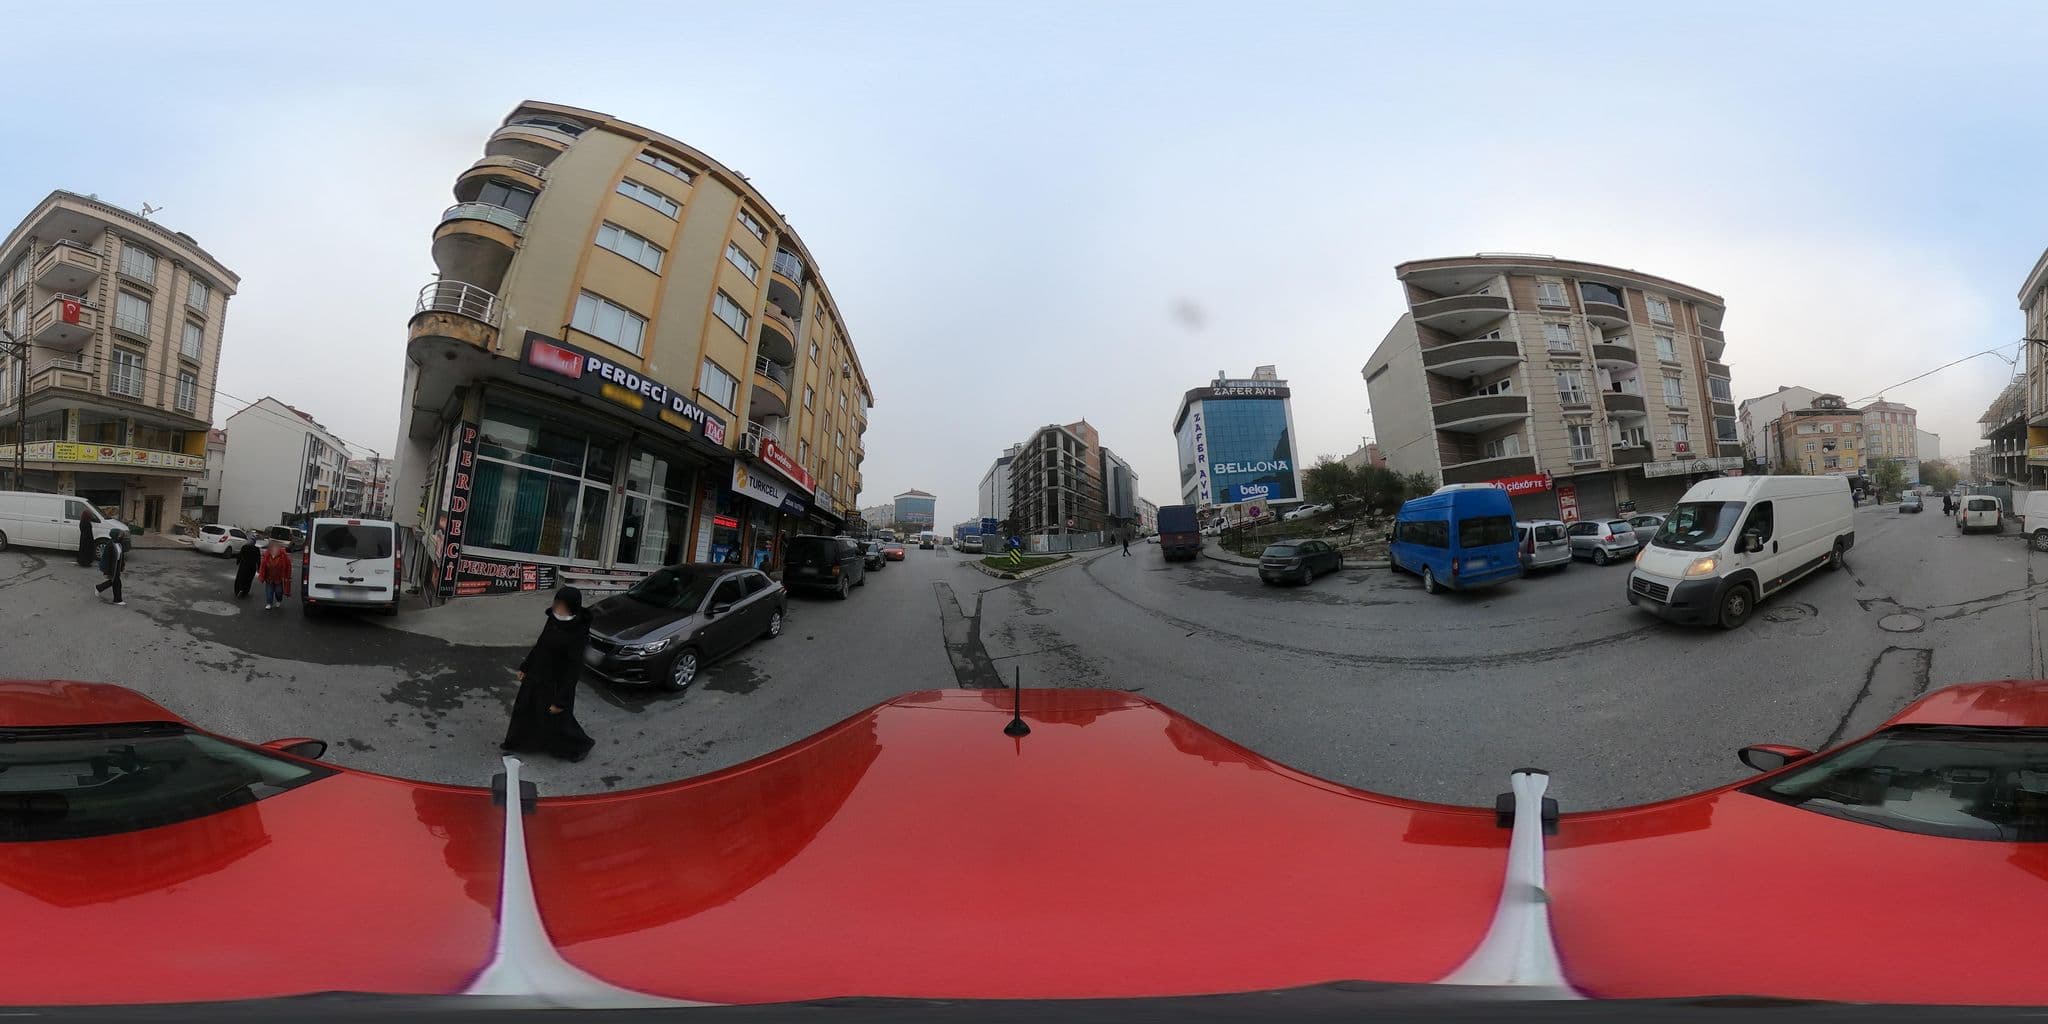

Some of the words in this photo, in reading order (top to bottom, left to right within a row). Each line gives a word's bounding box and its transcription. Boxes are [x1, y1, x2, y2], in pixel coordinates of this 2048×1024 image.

[587, 356, 668, 404] PERDECİ
[672, 396, 705, 425] DAYI
[706, 422, 724, 444] TAÇ
[1213, 387, 1253, 396] ZAFER
[1255, 387, 1276, 396] AVM
[1194, 413, 1205, 464] ZAFER
[1214, 460, 1289, 475] BELLONA
[748, 476, 779, 499] TURKCELL
[1199, 469, 1209, 500] AVM
[1240, 484, 1269, 496] beko
[1506, 480, 1544, 492] ÇİĞKÖFTE
[445, 428, 477, 581] PERDECİ
[458, 559, 521, 579] PERDECİ
[495, 579, 519, 588] DAYI
